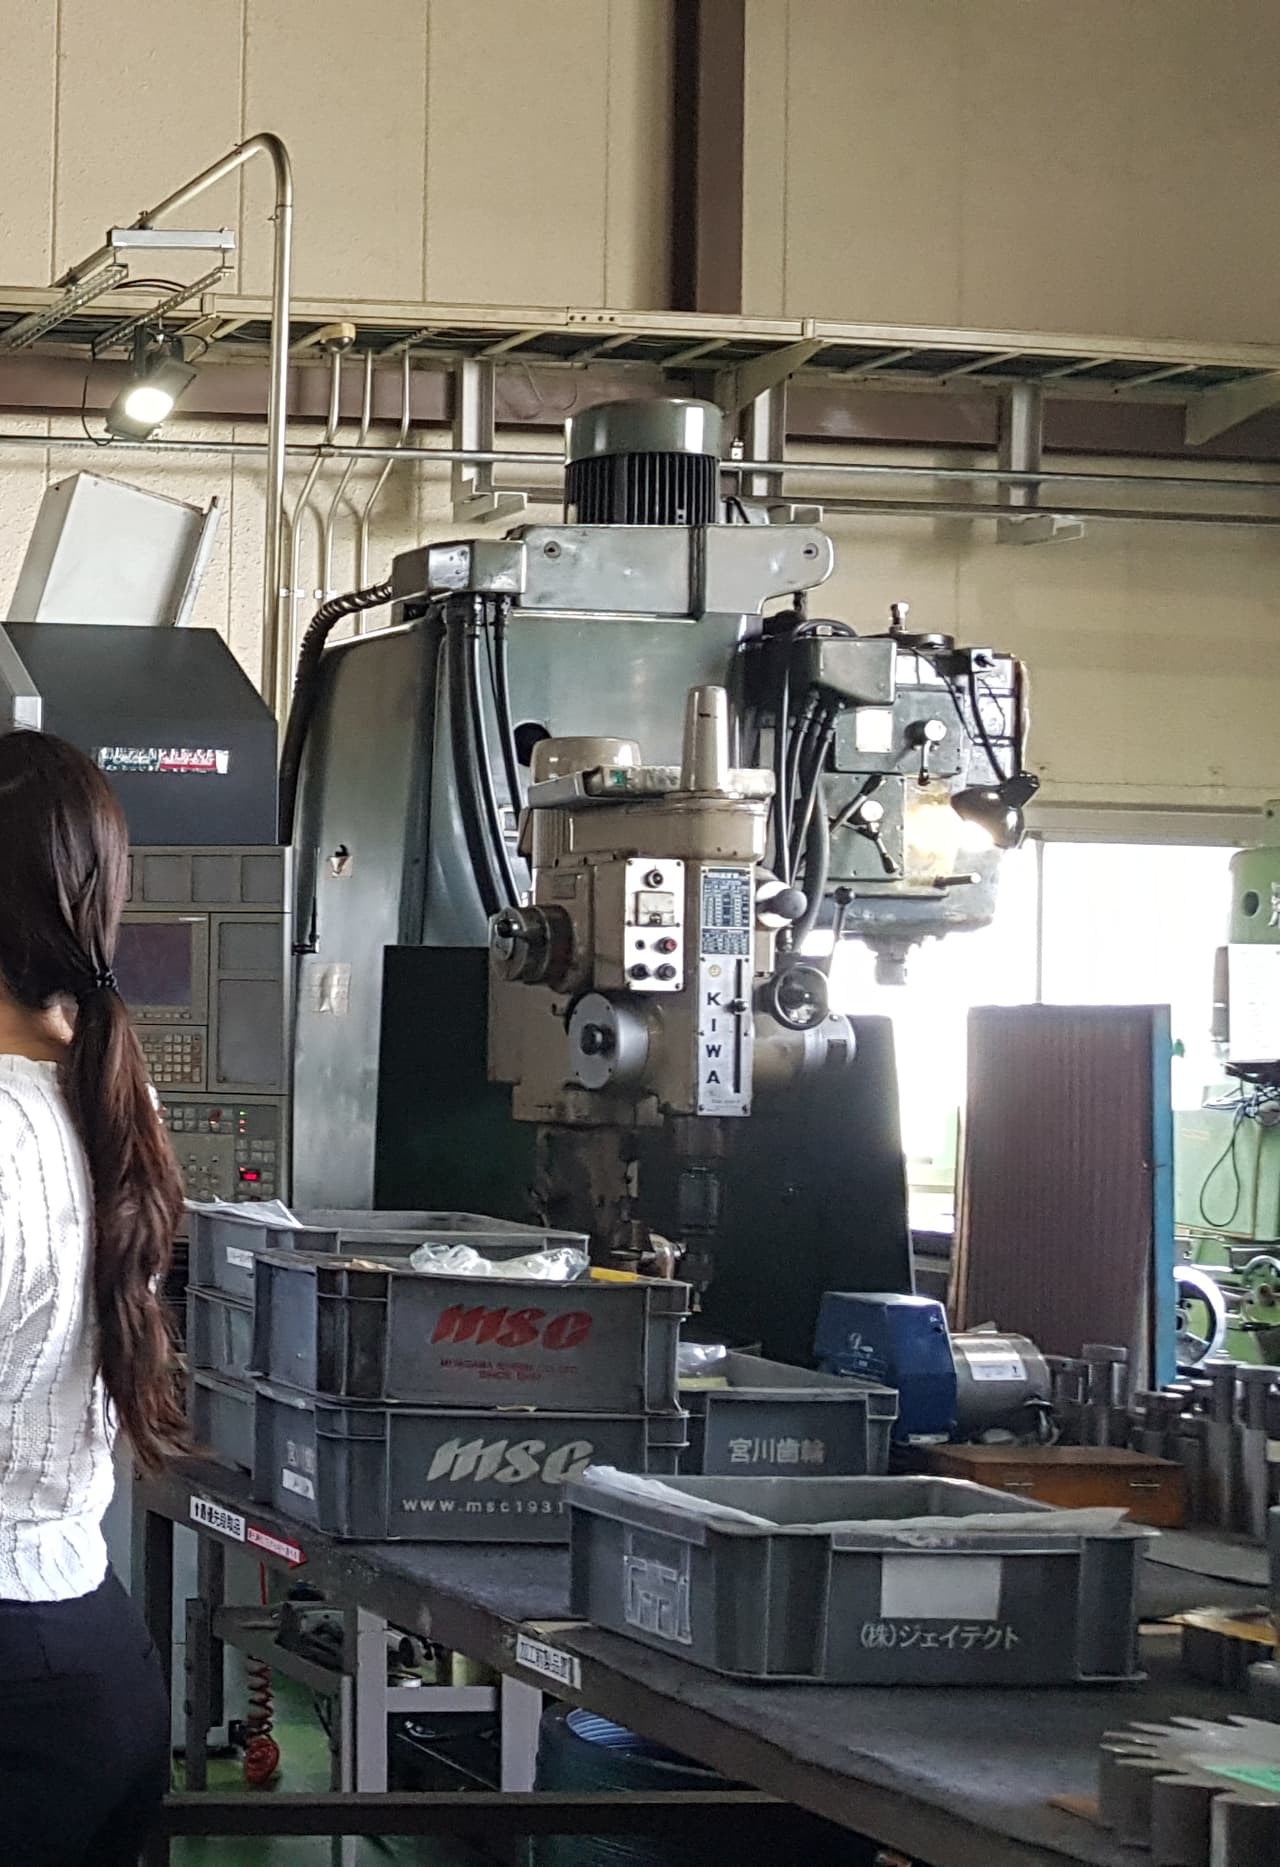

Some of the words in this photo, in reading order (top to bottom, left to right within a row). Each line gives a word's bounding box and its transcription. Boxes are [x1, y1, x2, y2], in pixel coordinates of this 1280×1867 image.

[706, 992, 722, 1085] KIWA
[860, 1623, 1019, 1649] (株)ジェイテクト
